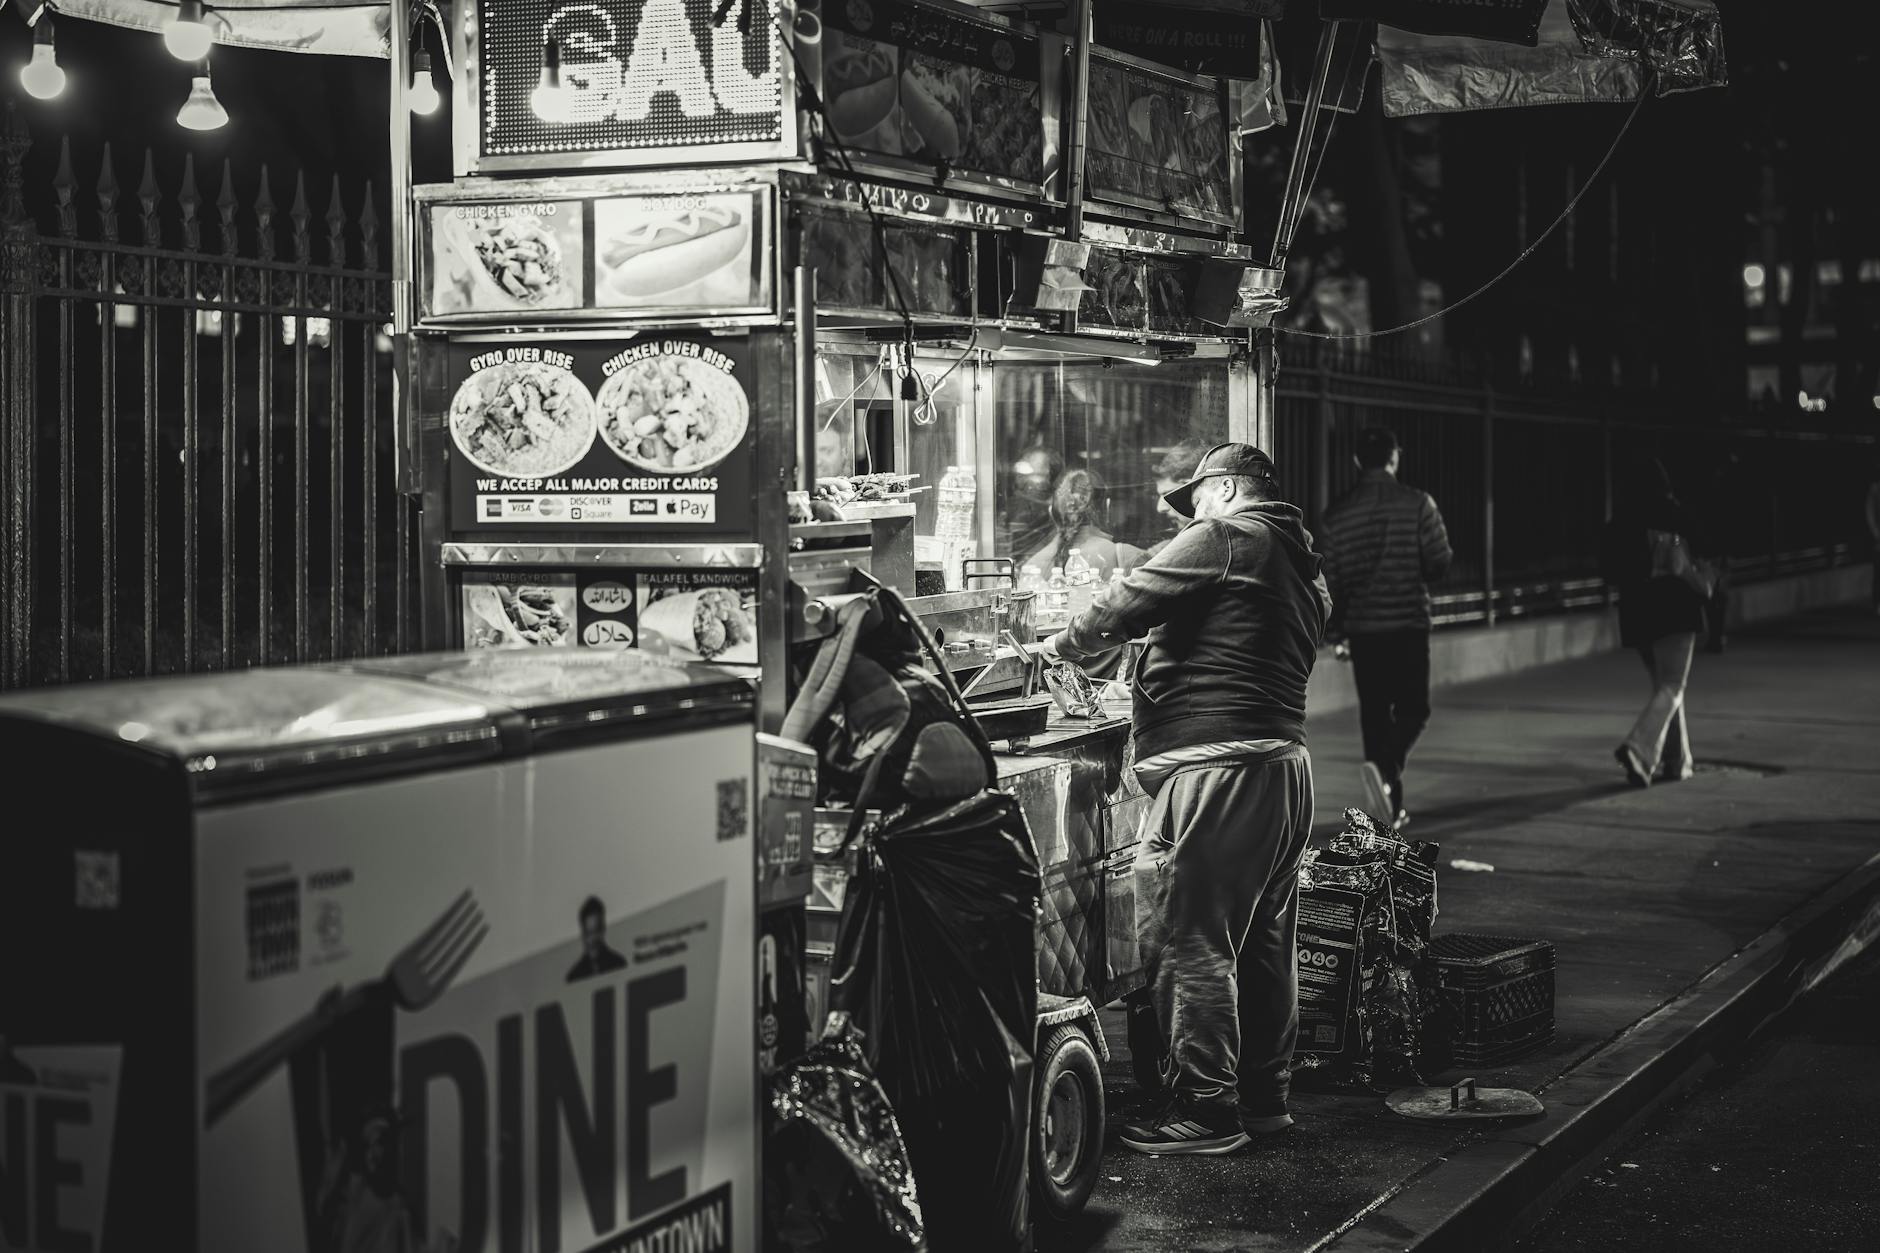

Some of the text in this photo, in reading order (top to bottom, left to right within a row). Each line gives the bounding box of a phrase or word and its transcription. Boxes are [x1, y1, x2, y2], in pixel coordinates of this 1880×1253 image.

[1184, 32, 1222, 47] ROLL
[456, 203, 557, 218] CHICKEN GYRO
[469, 348, 575, 372] GYRO OVER RISE
[601, 340, 736, 377] CHICKEN OVER RISE
[476, 477, 719, 491] WE ACCEP ALL MAJOR CREDIT CARDS
[511, 503, 532, 513] VISA
[570, 497, 613, 506] DISCOVER
[680, 499, 709, 519] Pay
[643, 574, 749, 585] FALAFEL SANDWICH
[587, 623, 630, 645] حلال
[400, 966, 688, 1253] DINE
